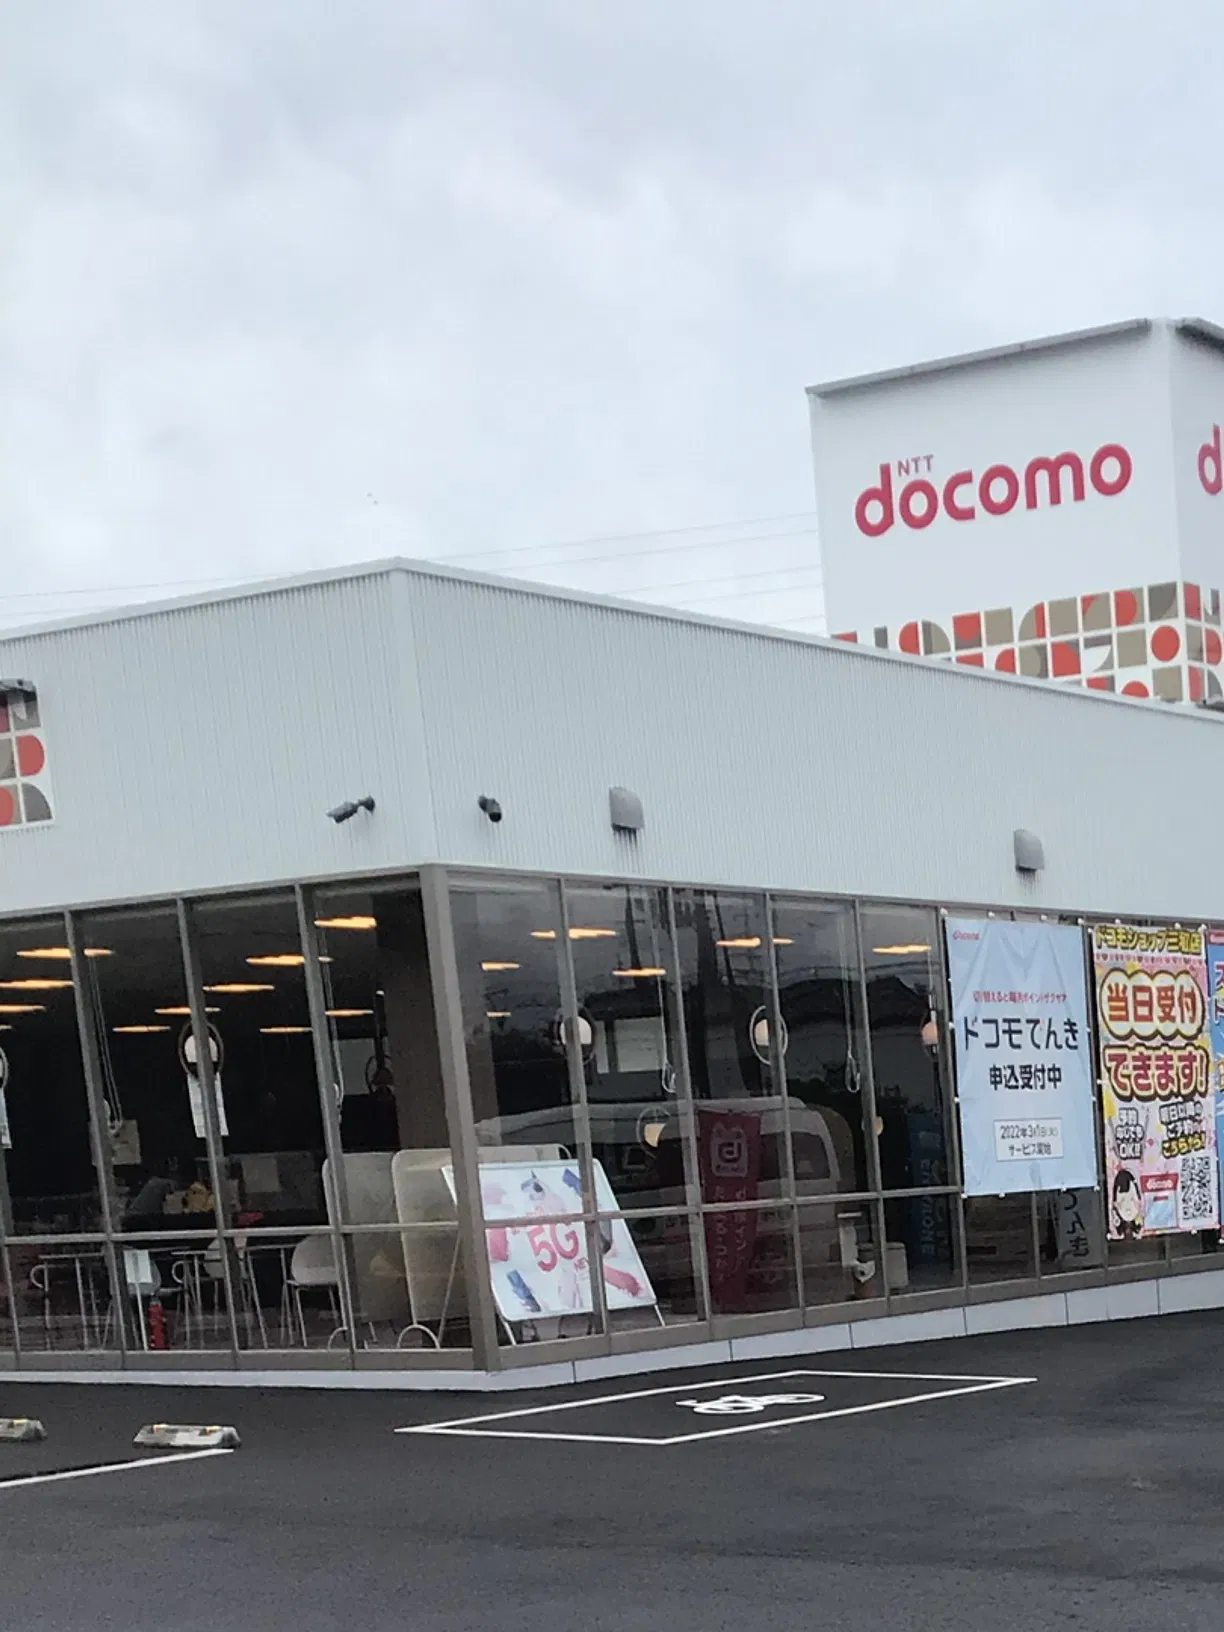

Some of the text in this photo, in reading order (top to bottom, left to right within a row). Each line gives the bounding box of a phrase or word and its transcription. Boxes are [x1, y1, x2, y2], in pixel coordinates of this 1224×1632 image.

[897, 454, 934, 477] NTT
[855, 443, 1132, 537] docomo
[1107, 982, 1197, 1024] 当日受付
[989, 1063, 1062, 1091] 申込受付中
[527, 1222, 580, 1272] 5G
